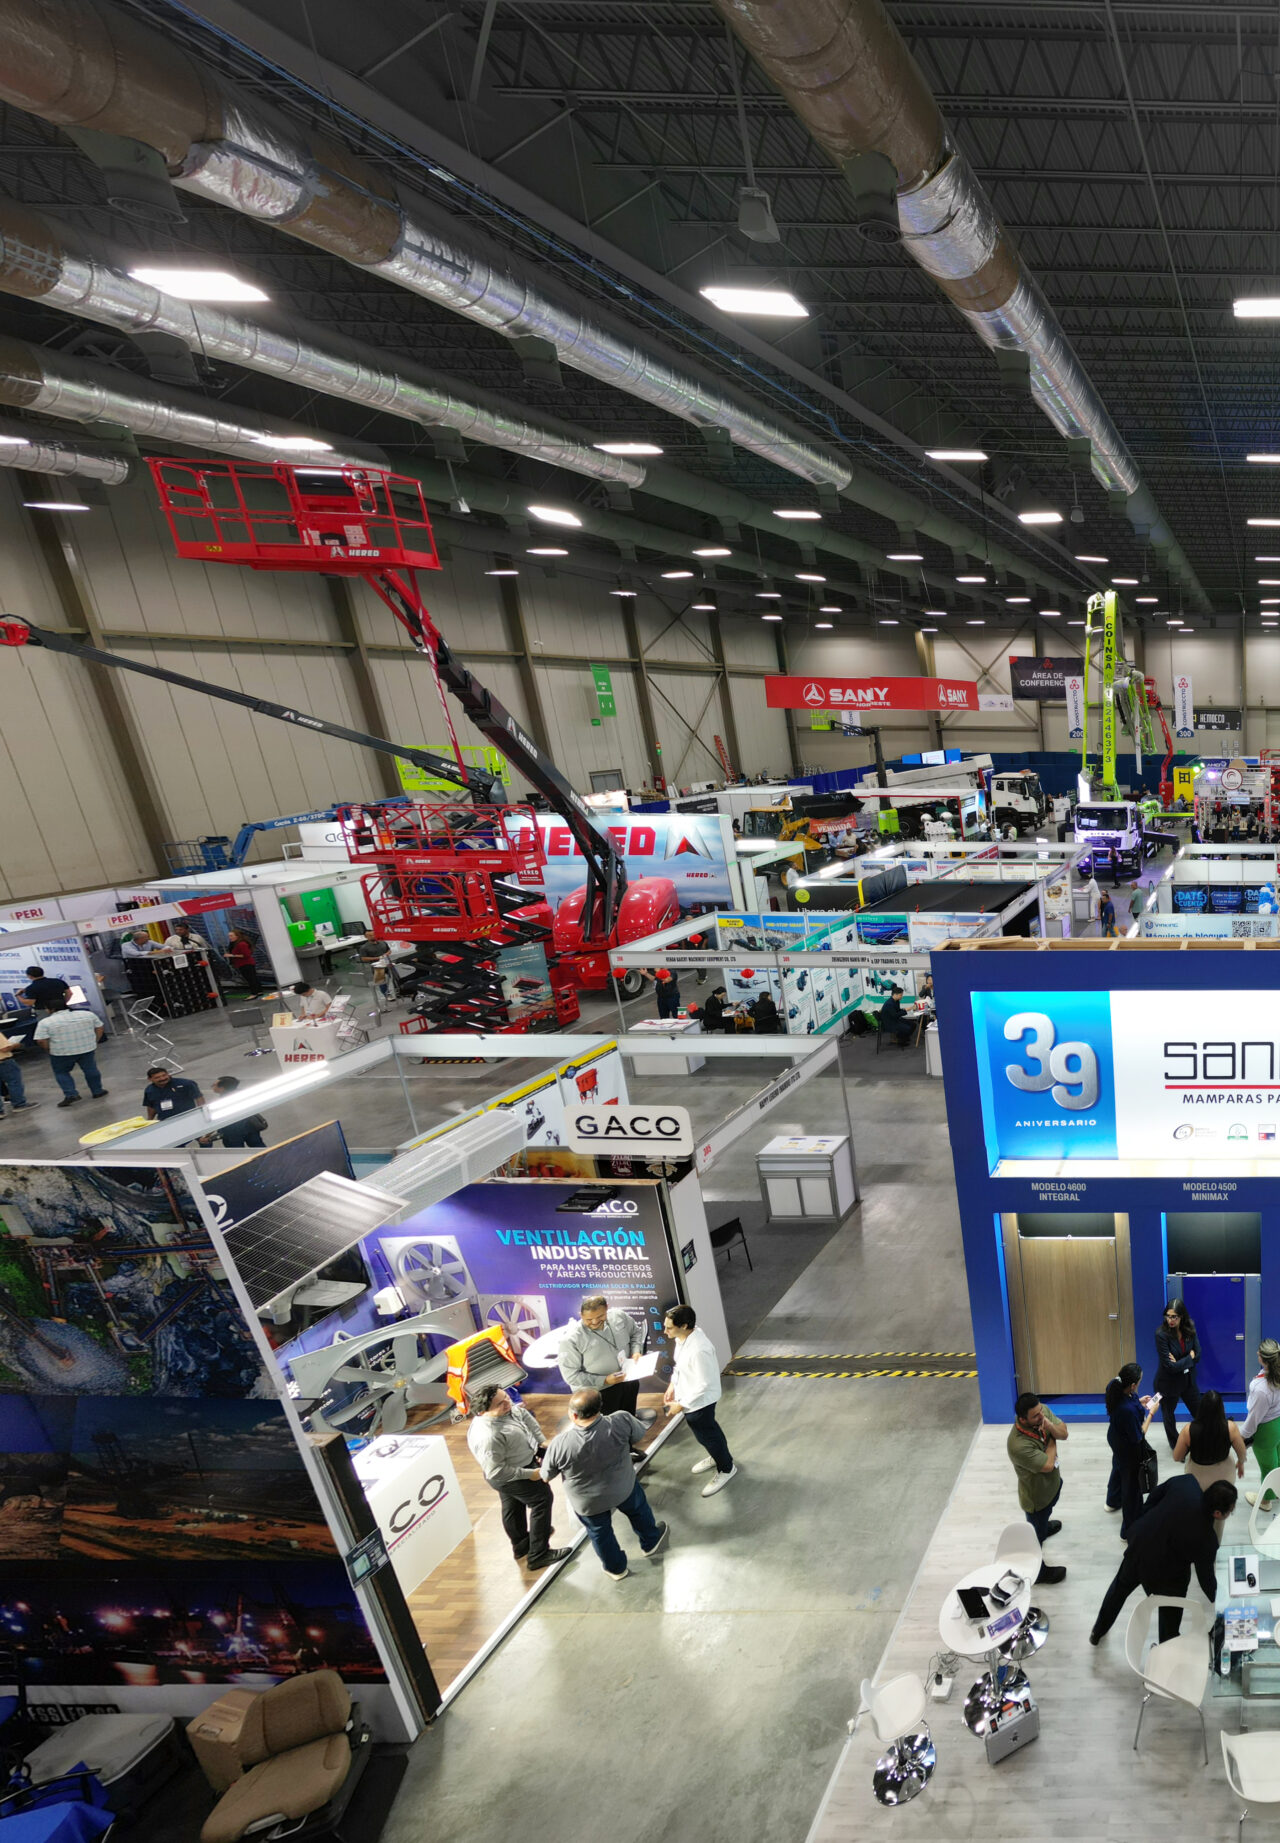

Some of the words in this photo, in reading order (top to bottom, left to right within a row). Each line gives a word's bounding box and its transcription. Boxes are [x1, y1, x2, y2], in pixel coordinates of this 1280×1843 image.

[348, 549, 380, 557] HERED
[1105, 622, 1113, 670] COINSA
[1031, 672, 1053, 680] ÁREA
[1053, 672, 1063, 680] DE
[1020, 679, 1066, 687] CONFERENC
[828, 687, 889, 702] SANY
[947, 689, 967, 703] SANY
[518, 732, 538, 760] HERED
[15, 908, 44, 920] PERI
[111, 914, 134, 925] PERI
[284, 1054, 325, 1063] HERED
[1003, 1012, 1099, 1111] 39
[1182, 1093, 1263, 1104] MAMPARAS
[575, 1115, 681, 1137] GACO
[1015, 1119, 1097, 1128] ANIVERSARIO
[1031, 1183, 1066, 1192] MODELO
[1067, 1183, 1087, 1192] 4600
[1183, 1183, 1218, 1192] MODELO
[1218, 1183, 1238, 1191] 4500
[1039, 1192, 1081, 1201] INTEGRAL
[1191, 1192, 1229, 1201] MINIMAX
[596, 1200, 638, 1213] ACO
[496, 1226, 646, 1246] VENTILACIÓN
[530, 1246, 649, 1260] INDUSTRIAL
[540, 1263, 566, 1271] PARA
[567, 1264, 600, 1272] NAVES,
[602, 1264, 652, 1272] PROCESOS
[556, 1270, 586, 1278] ÁREAS
[589, 1271, 653, 1279] PRODUCTIVAS
[389, 1474, 446, 1534] CO
